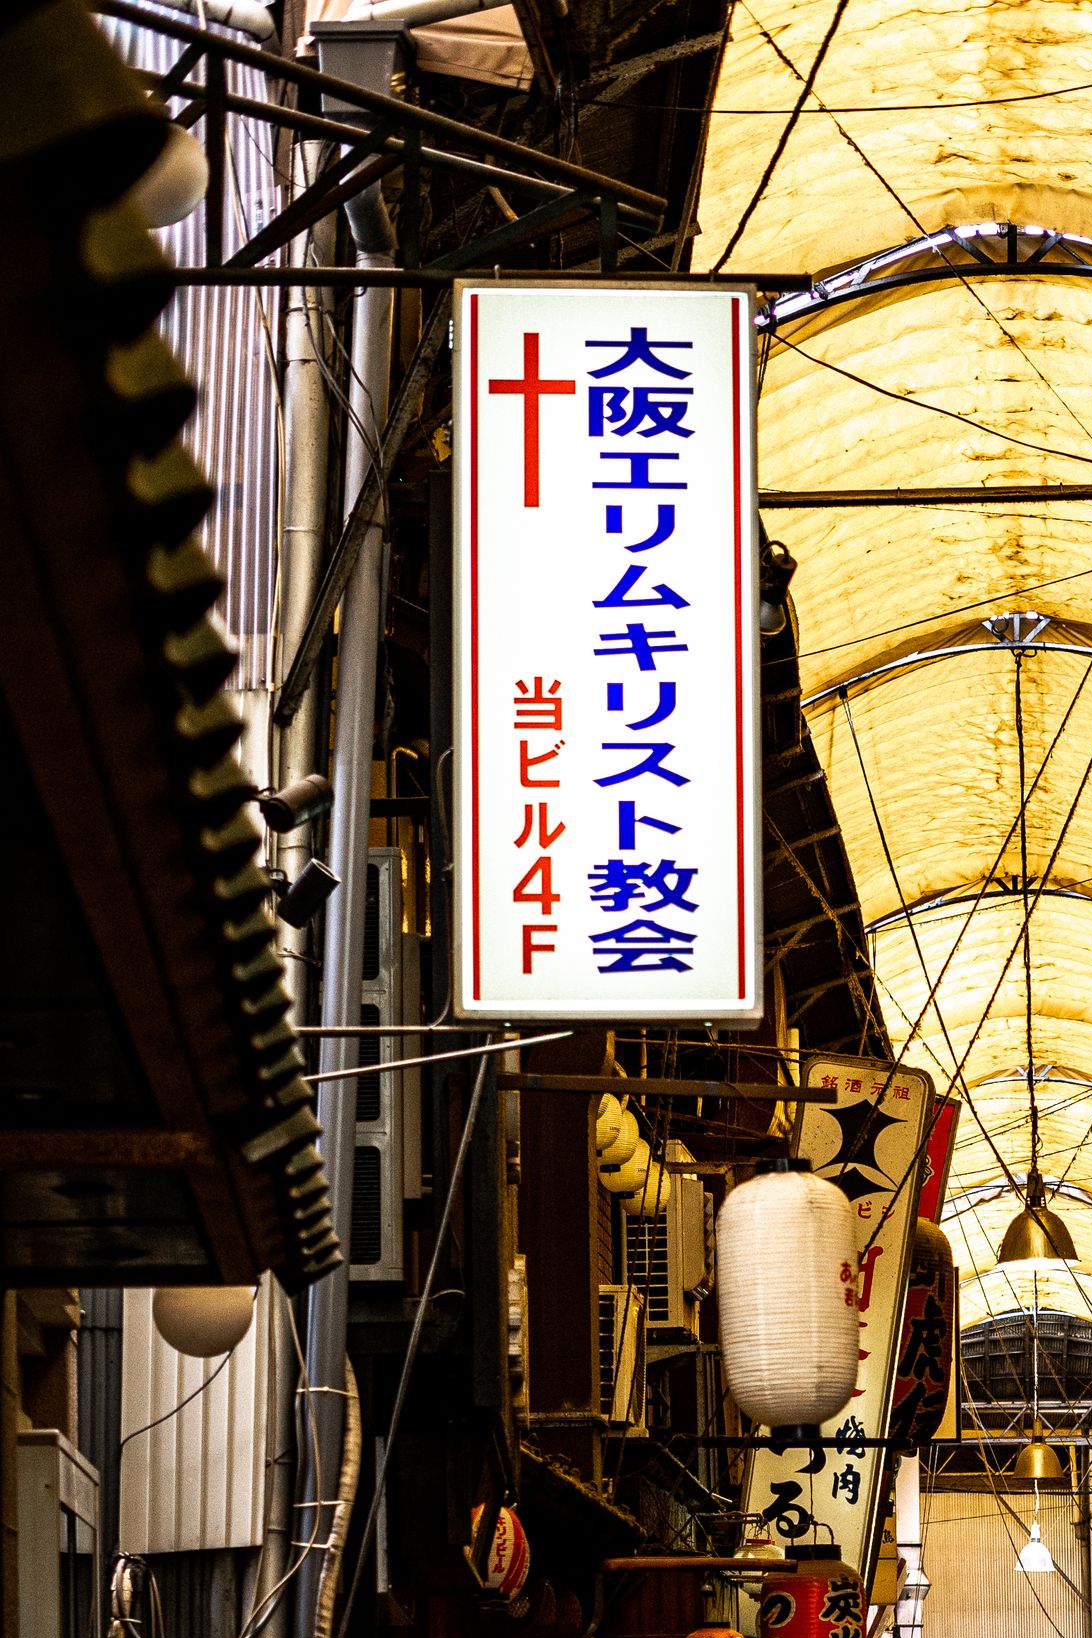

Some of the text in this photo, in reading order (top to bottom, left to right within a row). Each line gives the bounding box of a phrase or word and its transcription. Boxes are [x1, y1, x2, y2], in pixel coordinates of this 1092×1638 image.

[513, 677, 566, 976] 当ビル4F
[584, 327, 699, 975] 大阪エリムキリスト教会
